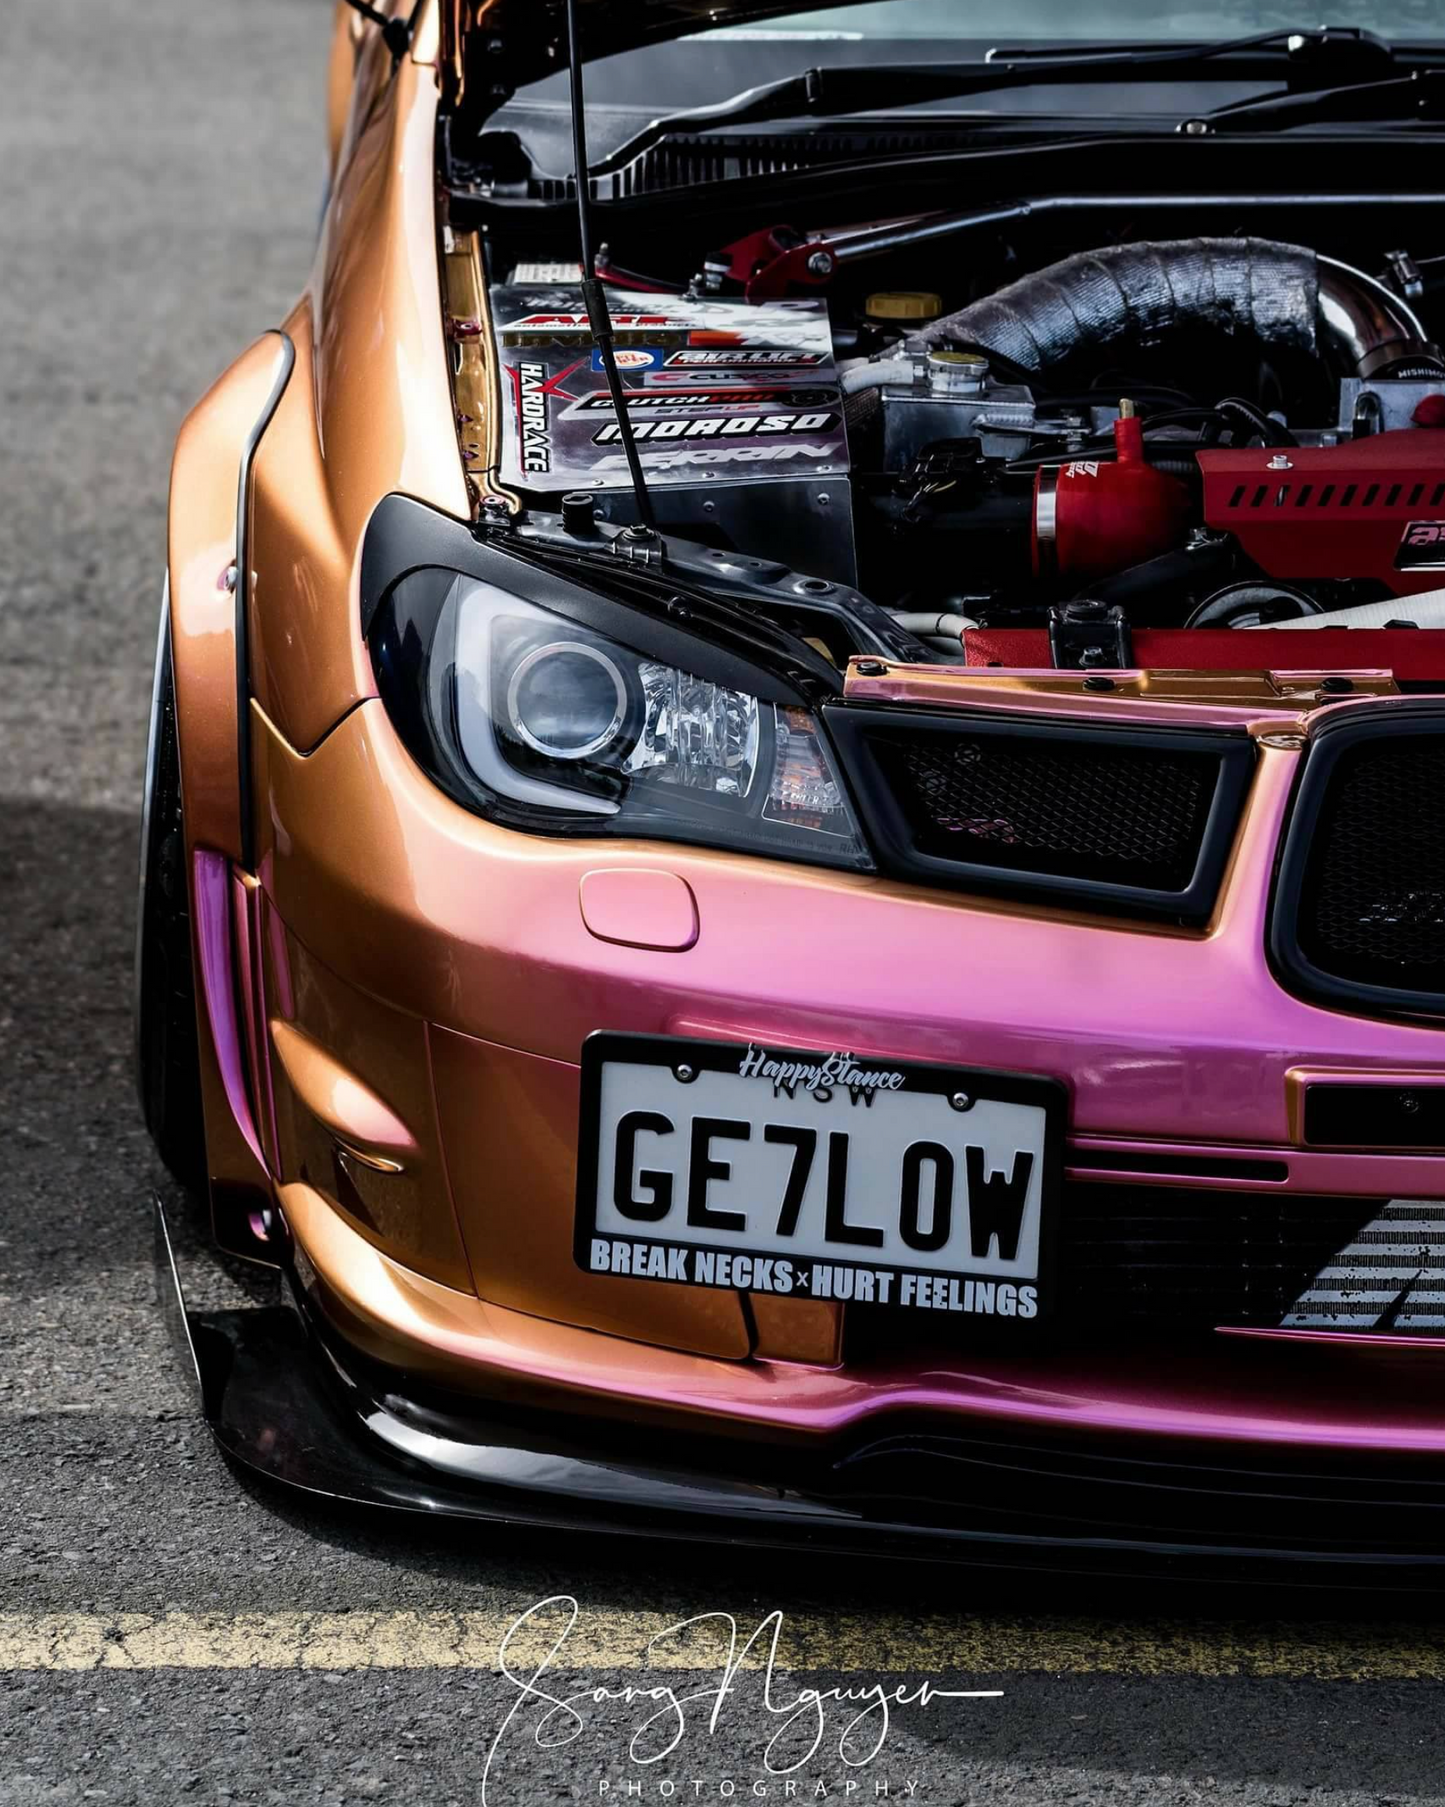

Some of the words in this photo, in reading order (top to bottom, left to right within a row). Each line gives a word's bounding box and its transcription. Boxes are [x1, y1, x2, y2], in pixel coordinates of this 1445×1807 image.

[520, 362, 549, 473] HARDRACE
[595, 413, 832, 441] MOROSO
[613, 1110, 1035, 1261] GE7LOW
[590, 1238, 689, 1281] BREAK
[694, 1251, 796, 1293] NECKS
[811, 1264, 896, 1304] HURT
[900, 1273, 1039, 1319] FEELINGS
